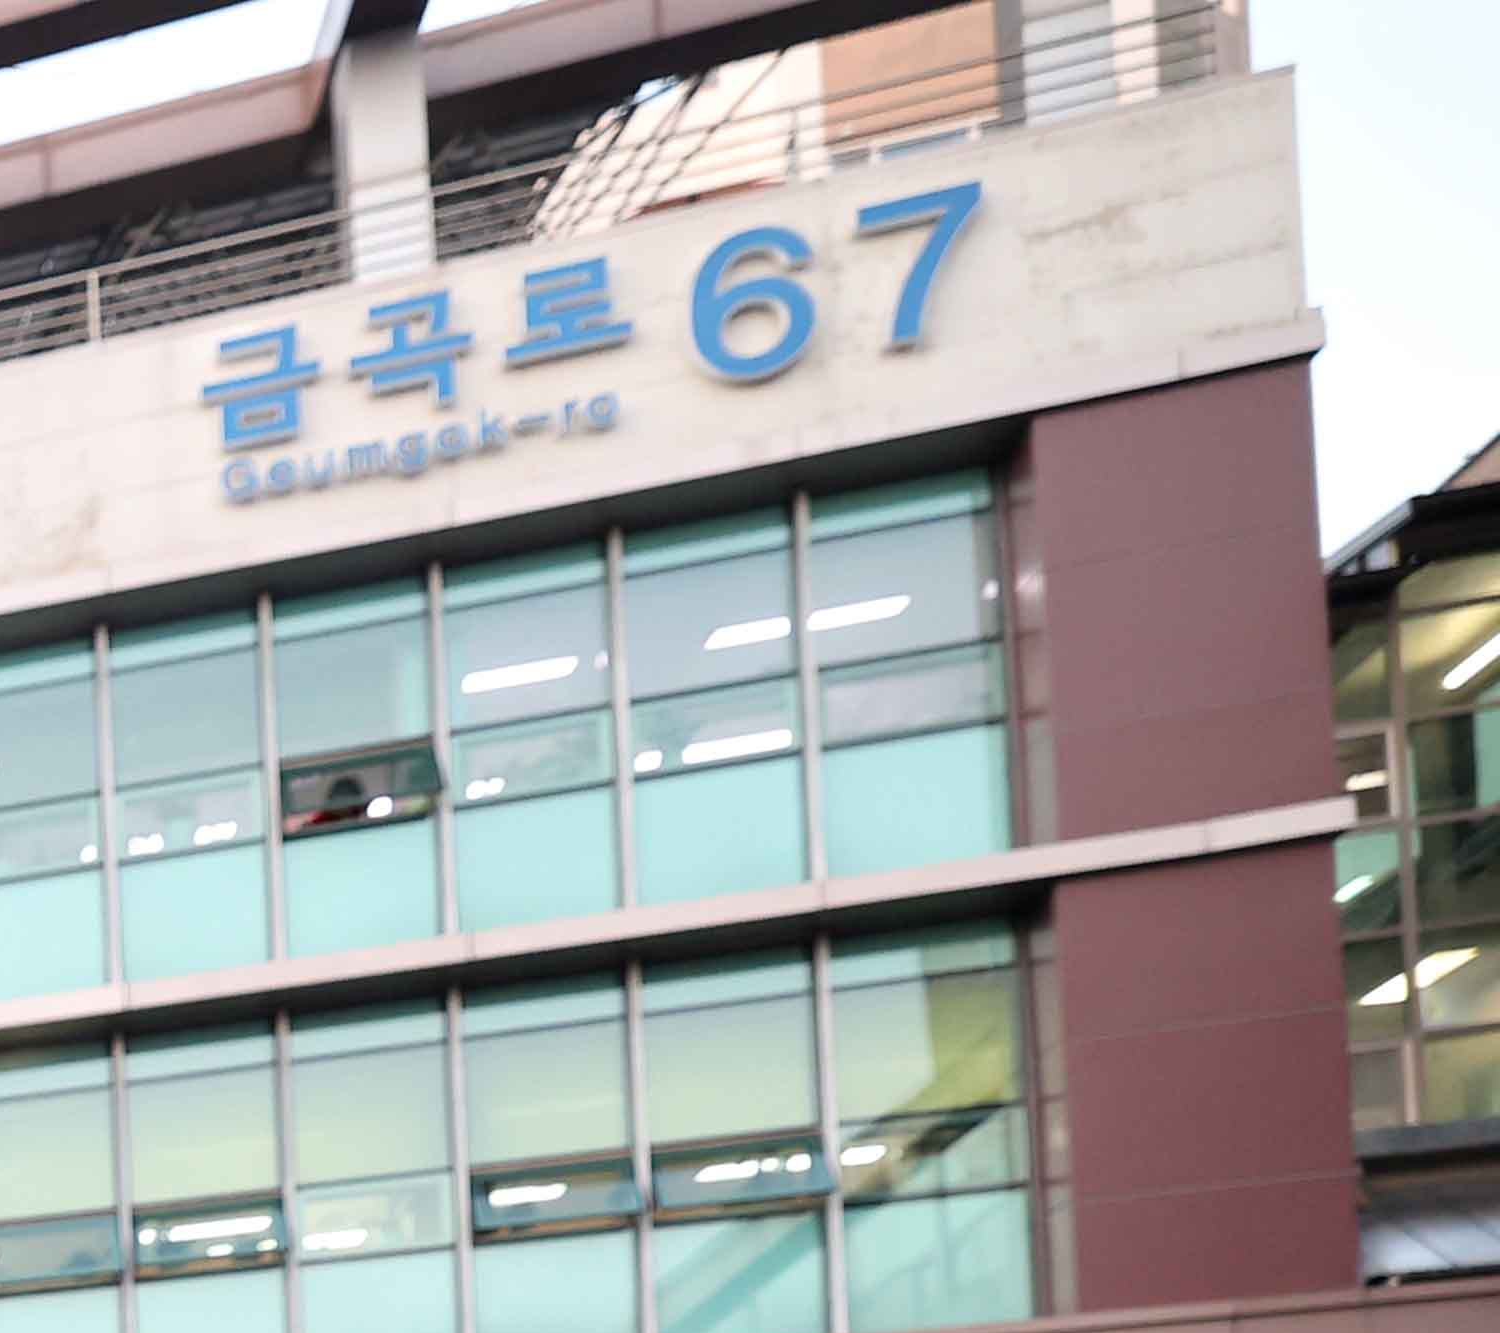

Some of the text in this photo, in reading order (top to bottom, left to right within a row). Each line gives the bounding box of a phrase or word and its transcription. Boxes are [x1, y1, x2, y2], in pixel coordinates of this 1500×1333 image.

[201, 180, 984, 450] 금곡로 67
[221, 390, 621, 508] Geumgok-ro
